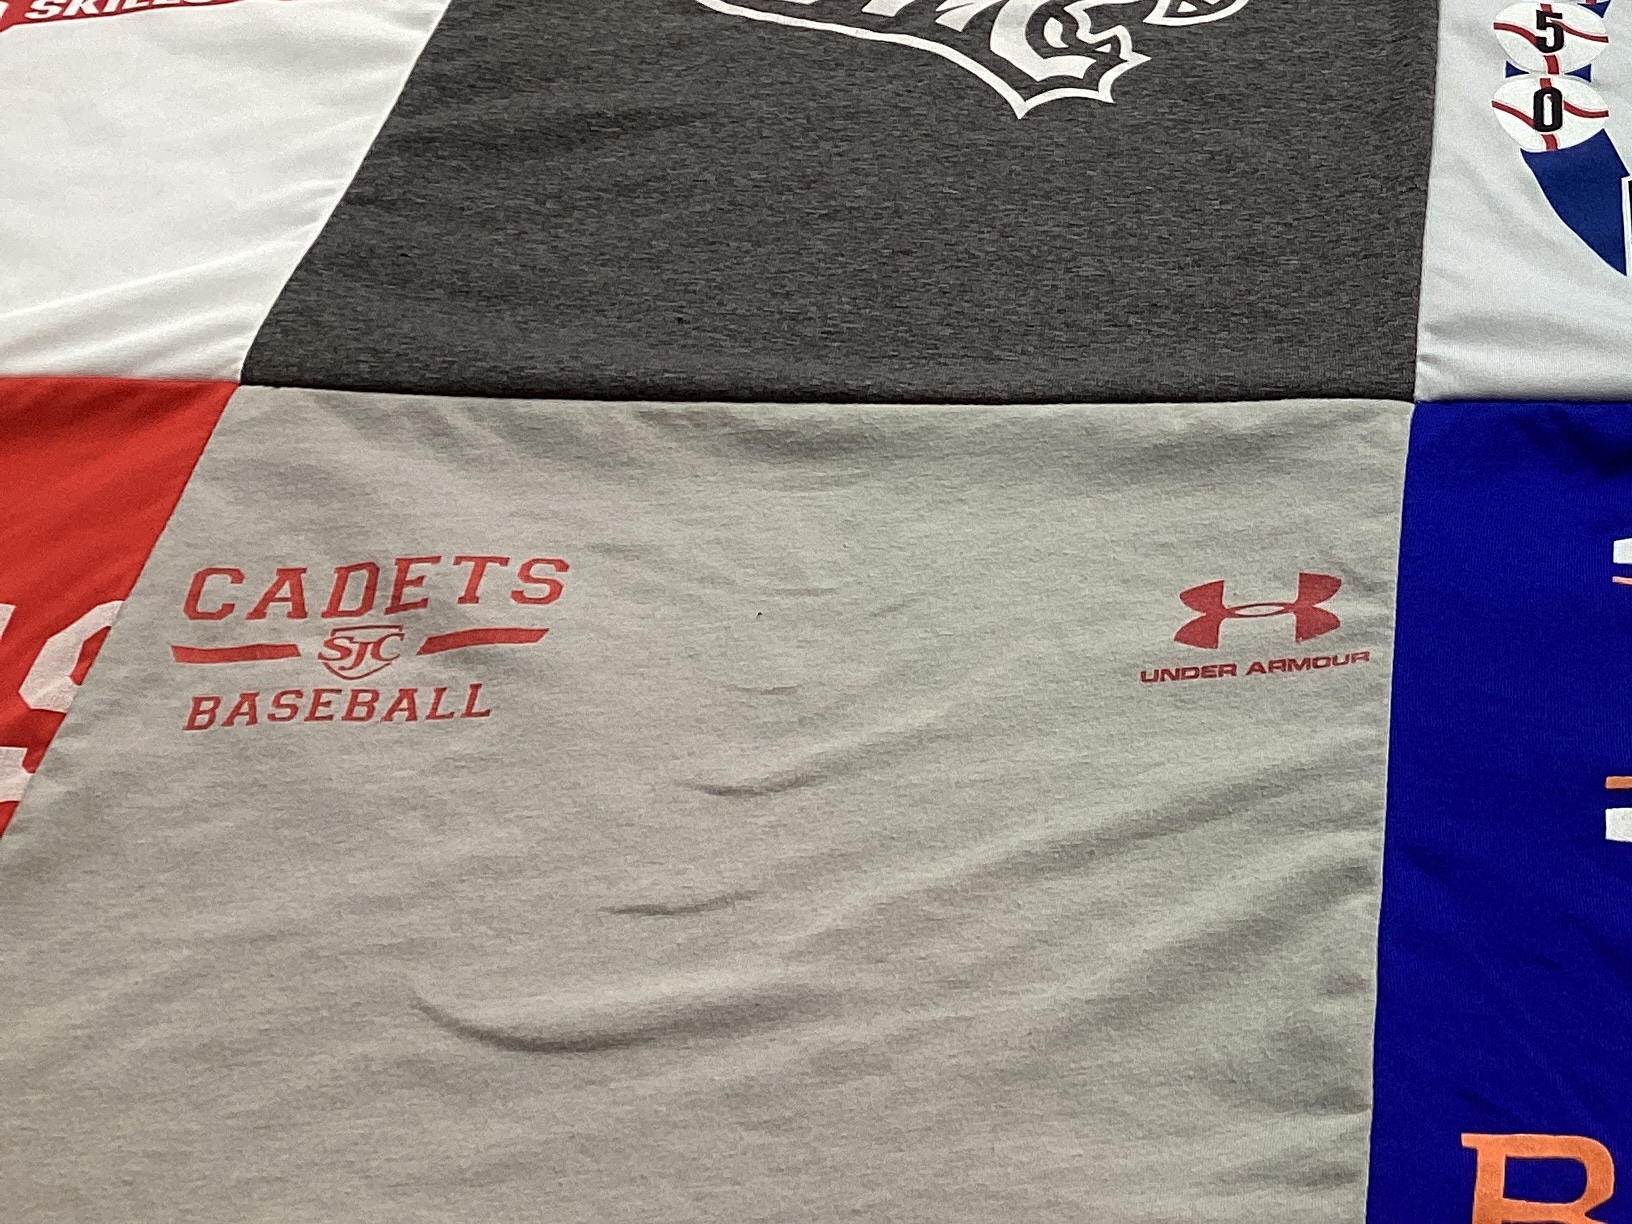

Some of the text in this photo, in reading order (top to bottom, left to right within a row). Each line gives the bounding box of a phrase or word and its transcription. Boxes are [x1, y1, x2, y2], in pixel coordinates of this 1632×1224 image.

[1535, 9, 1565, 54] 5
[1532, 86, 1564, 134] 0
[182, 555, 571, 622] CADETS
[317, 631, 406, 671] SJC
[1139, 650, 1371, 683] UNDER ARMOUR
[182, 683, 492, 732] BASEBALL
